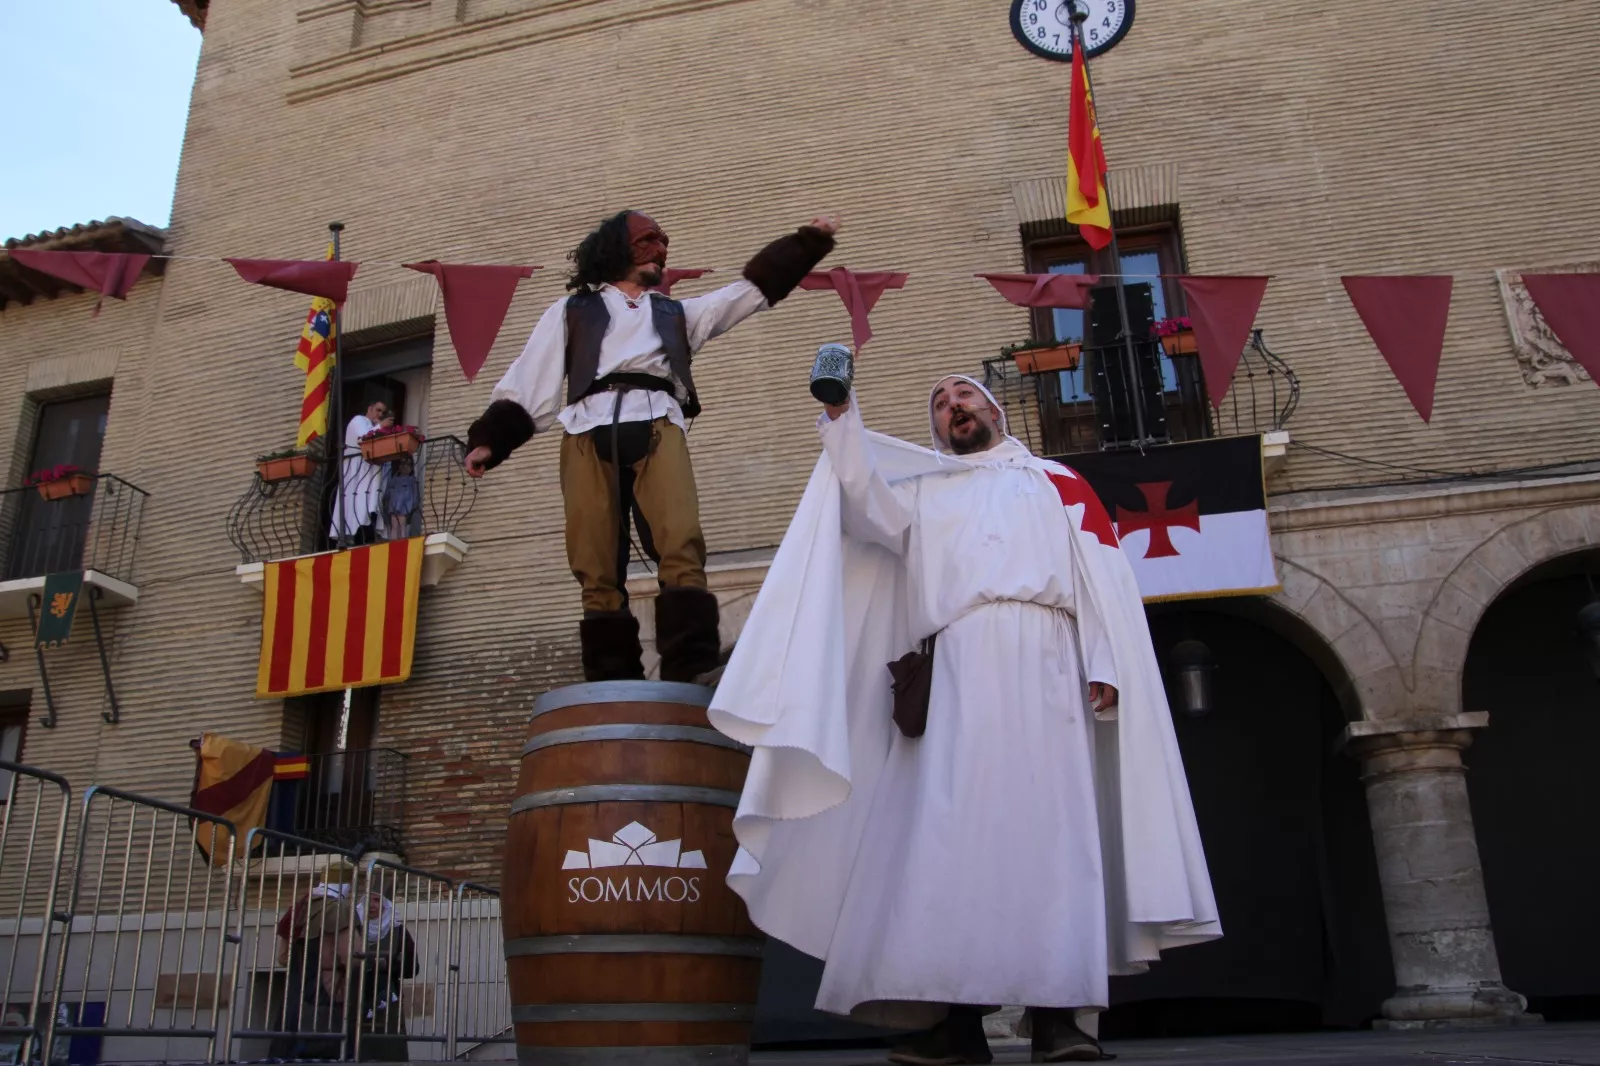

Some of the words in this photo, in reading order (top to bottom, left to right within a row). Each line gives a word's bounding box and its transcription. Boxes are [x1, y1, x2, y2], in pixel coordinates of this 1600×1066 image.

[1107, 1, 1116, 13] 3
[1029, 13, 1038, 25] 9
[1102, 16, 1111, 28] 4
[1037, 26, 1046, 39] 8
[1090, 28, 1098, 41] 5
[1052, 34, 1061, 46] 7
[568, 876, 701, 903] SOMMOS
